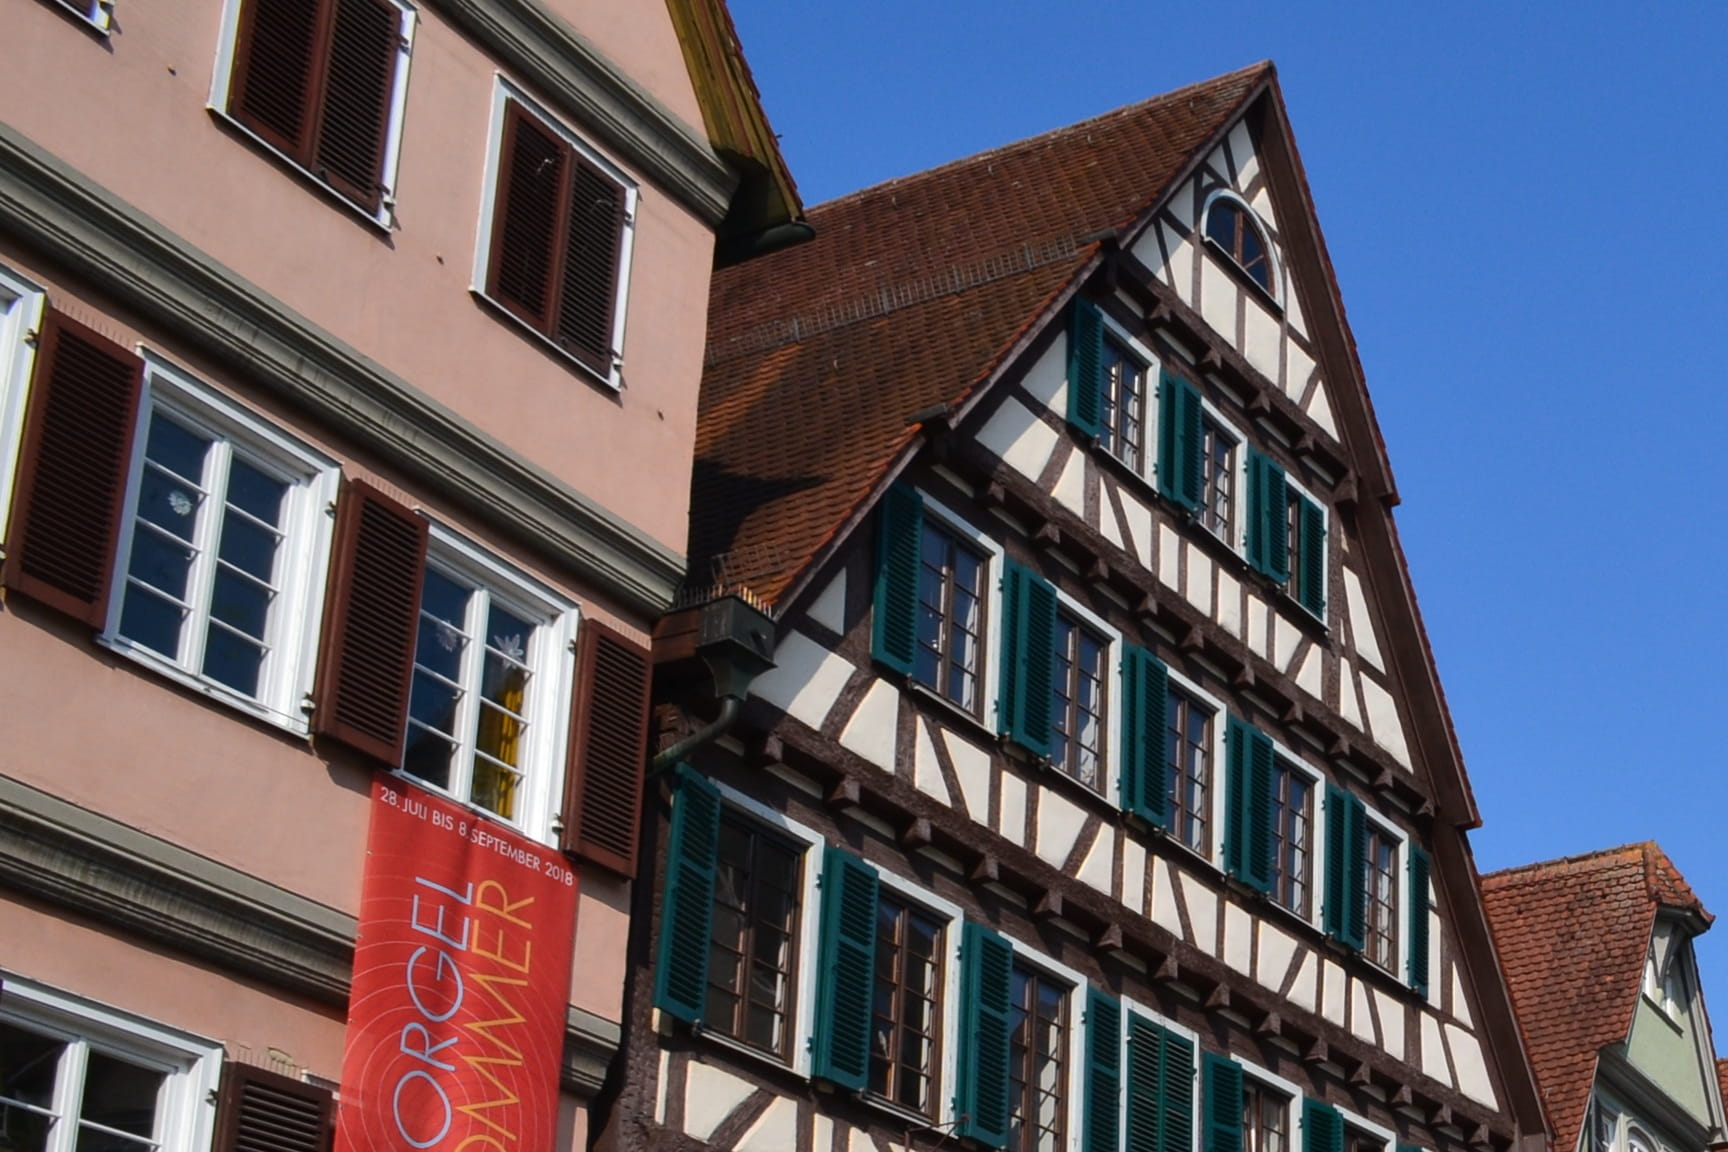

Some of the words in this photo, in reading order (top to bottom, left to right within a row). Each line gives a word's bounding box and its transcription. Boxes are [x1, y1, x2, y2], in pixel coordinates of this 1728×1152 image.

[380, 786, 400, 808] 28.
[402, 798, 428, 820] JULI
[432, 810, 454, 831] BIS
[470, 828, 541, 871] SEPTEMBER
[545, 861, 574, 886] 2018
[393, 876, 473, 1149] ORGEL
